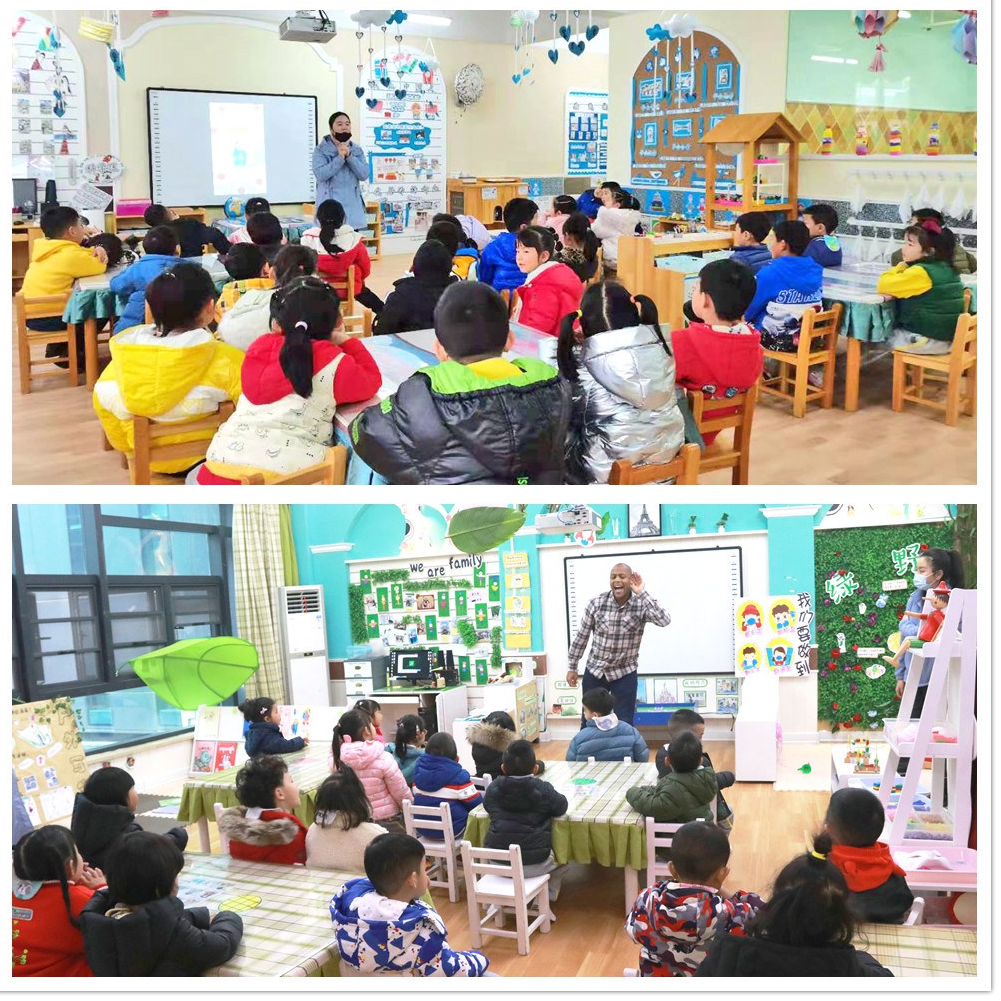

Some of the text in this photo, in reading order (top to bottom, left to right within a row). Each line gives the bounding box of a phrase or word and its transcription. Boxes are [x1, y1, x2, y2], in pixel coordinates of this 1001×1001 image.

[448, 554, 482, 569] family
[409, 563, 424, 573] we
[427, 567, 445, 577] are
[795, 592, 814, 677] 我们要做到
